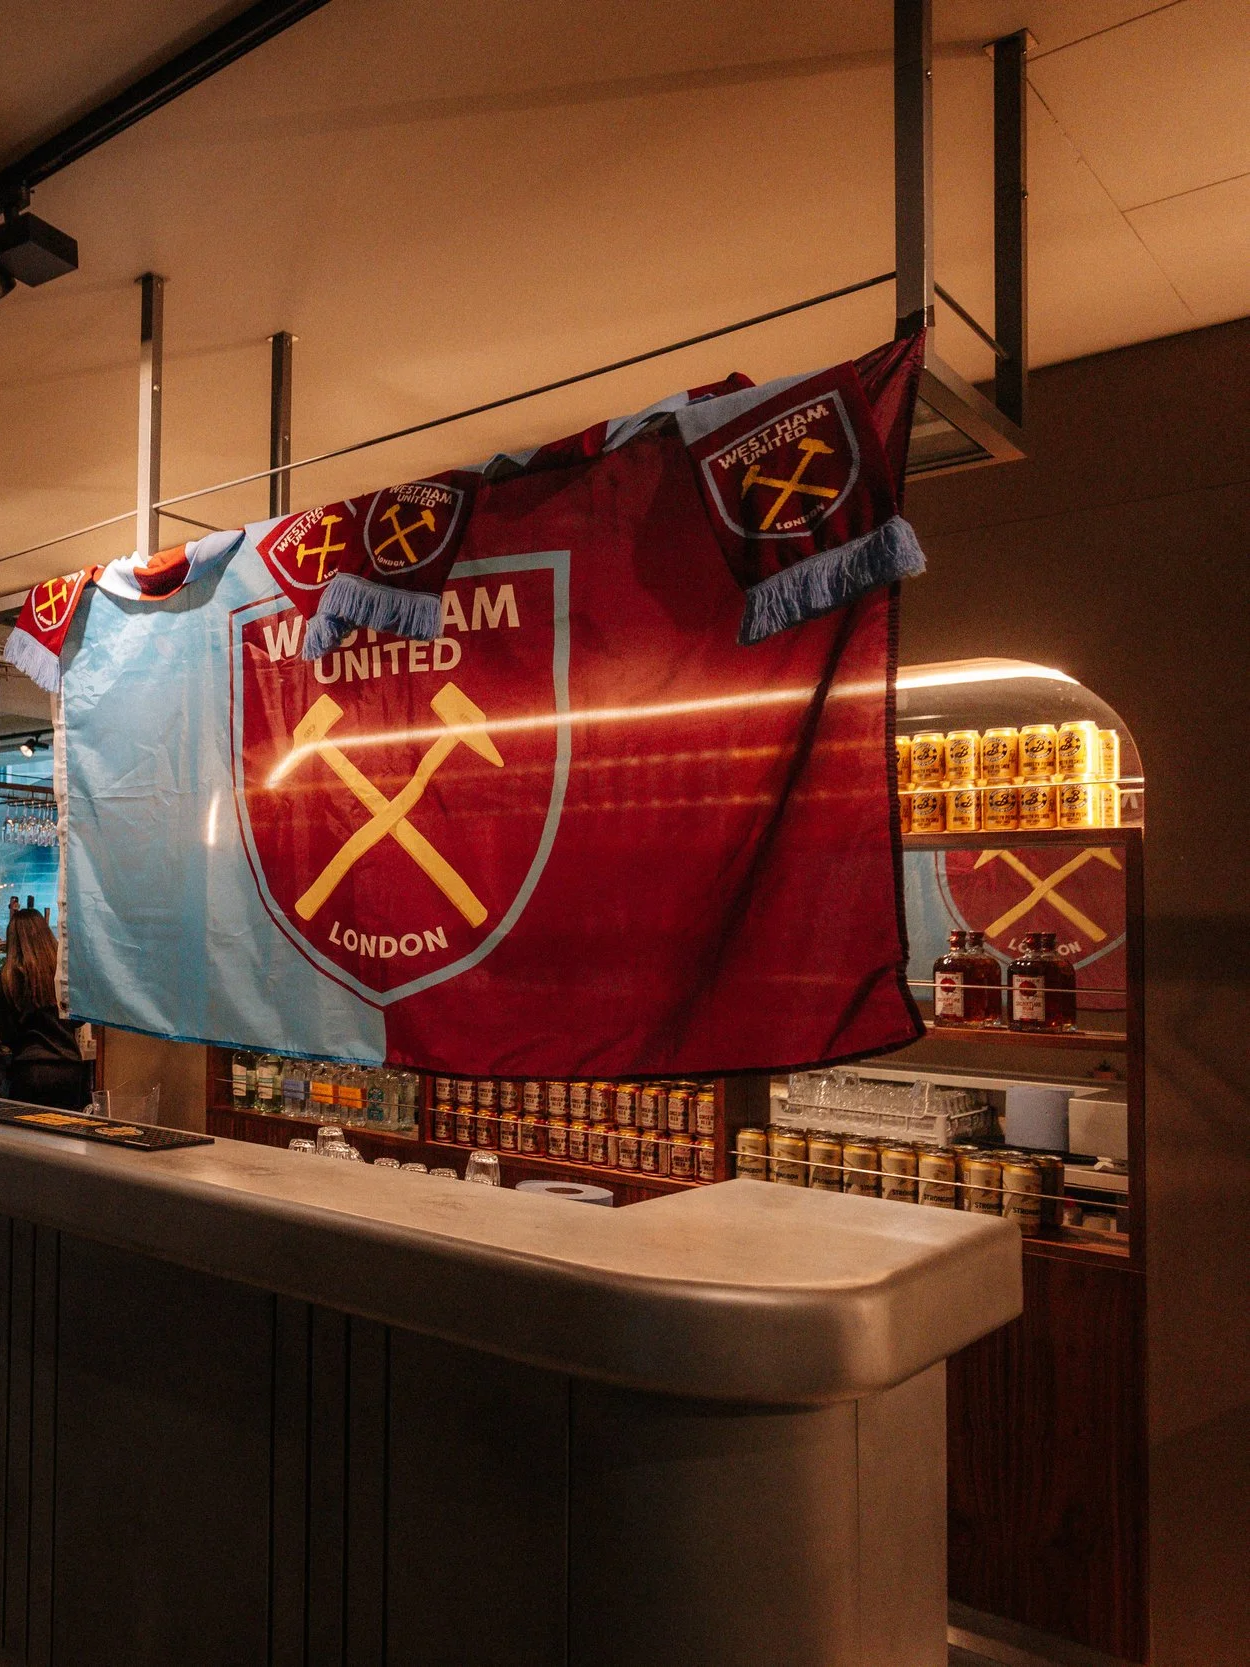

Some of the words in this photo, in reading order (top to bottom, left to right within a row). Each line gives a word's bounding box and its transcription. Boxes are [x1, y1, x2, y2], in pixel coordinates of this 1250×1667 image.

[718, 429, 771, 470] WEST
[776, 404, 830, 435] HAM
[742, 426, 808, 466] UNITED
[389, 484, 422, 495] WEST
[421, 487, 452, 504] HAM
[397, 494, 436, 507] UNITED
[277, 520, 304, 552] WEST
[305, 505, 327, 522] HA
[292, 510, 324, 546] UNITED
[775, 503, 825, 531] LONDON
[377, 554, 405, 567] LONDON
[442, 583, 520, 632] AM
[314, 637, 462, 685] UNITED
[328, 921, 448, 958] LONDON
[1008, 937, 1082, 956] LOON
